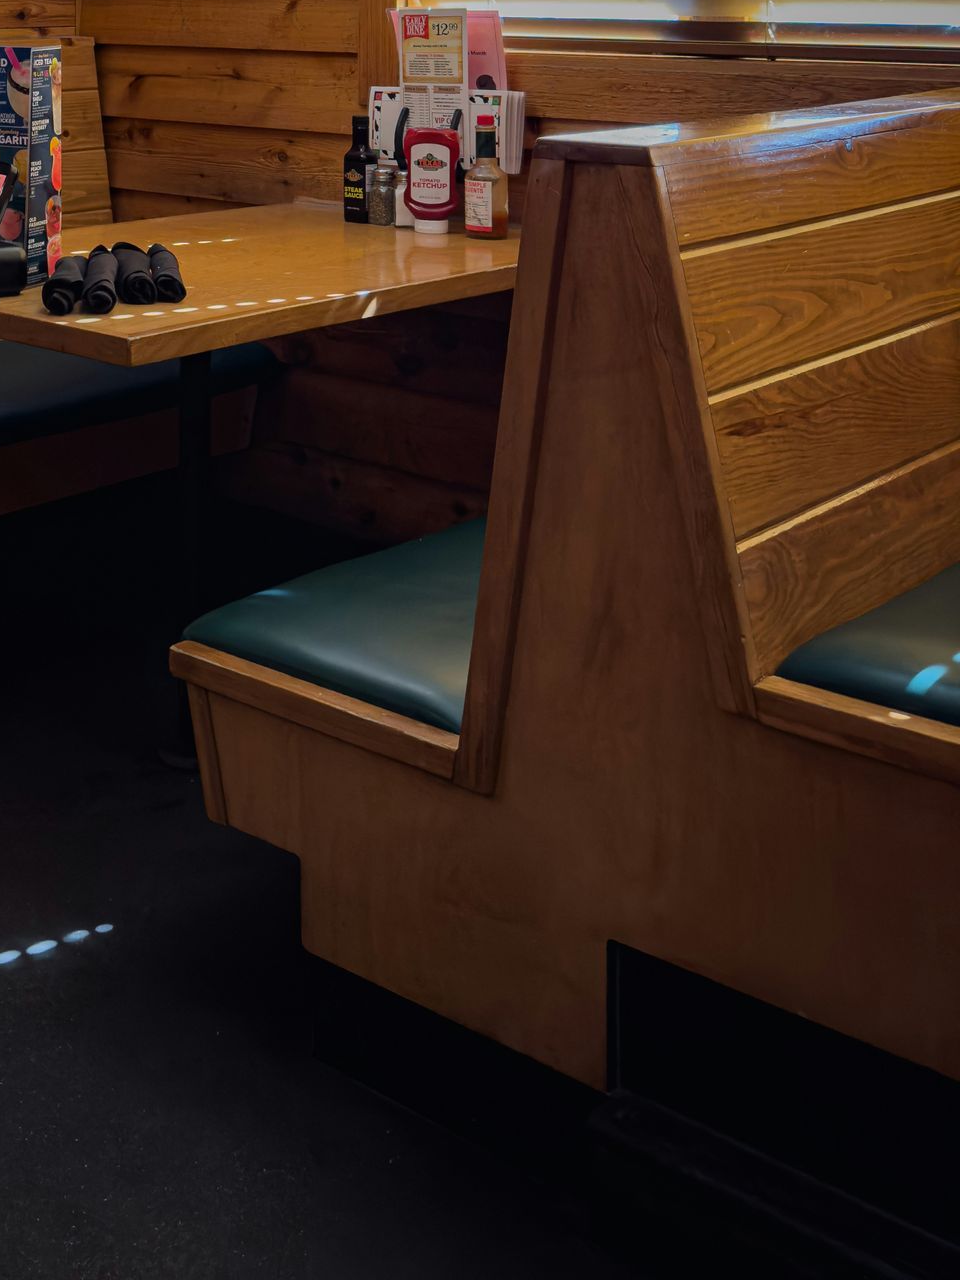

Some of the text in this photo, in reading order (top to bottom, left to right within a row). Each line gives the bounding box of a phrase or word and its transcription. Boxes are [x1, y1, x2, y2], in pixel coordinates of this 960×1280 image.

[405, 15, 427, 25] EARLY
[406, 25, 425, 36] DINE
[419, 159, 442, 167] TEXAS
